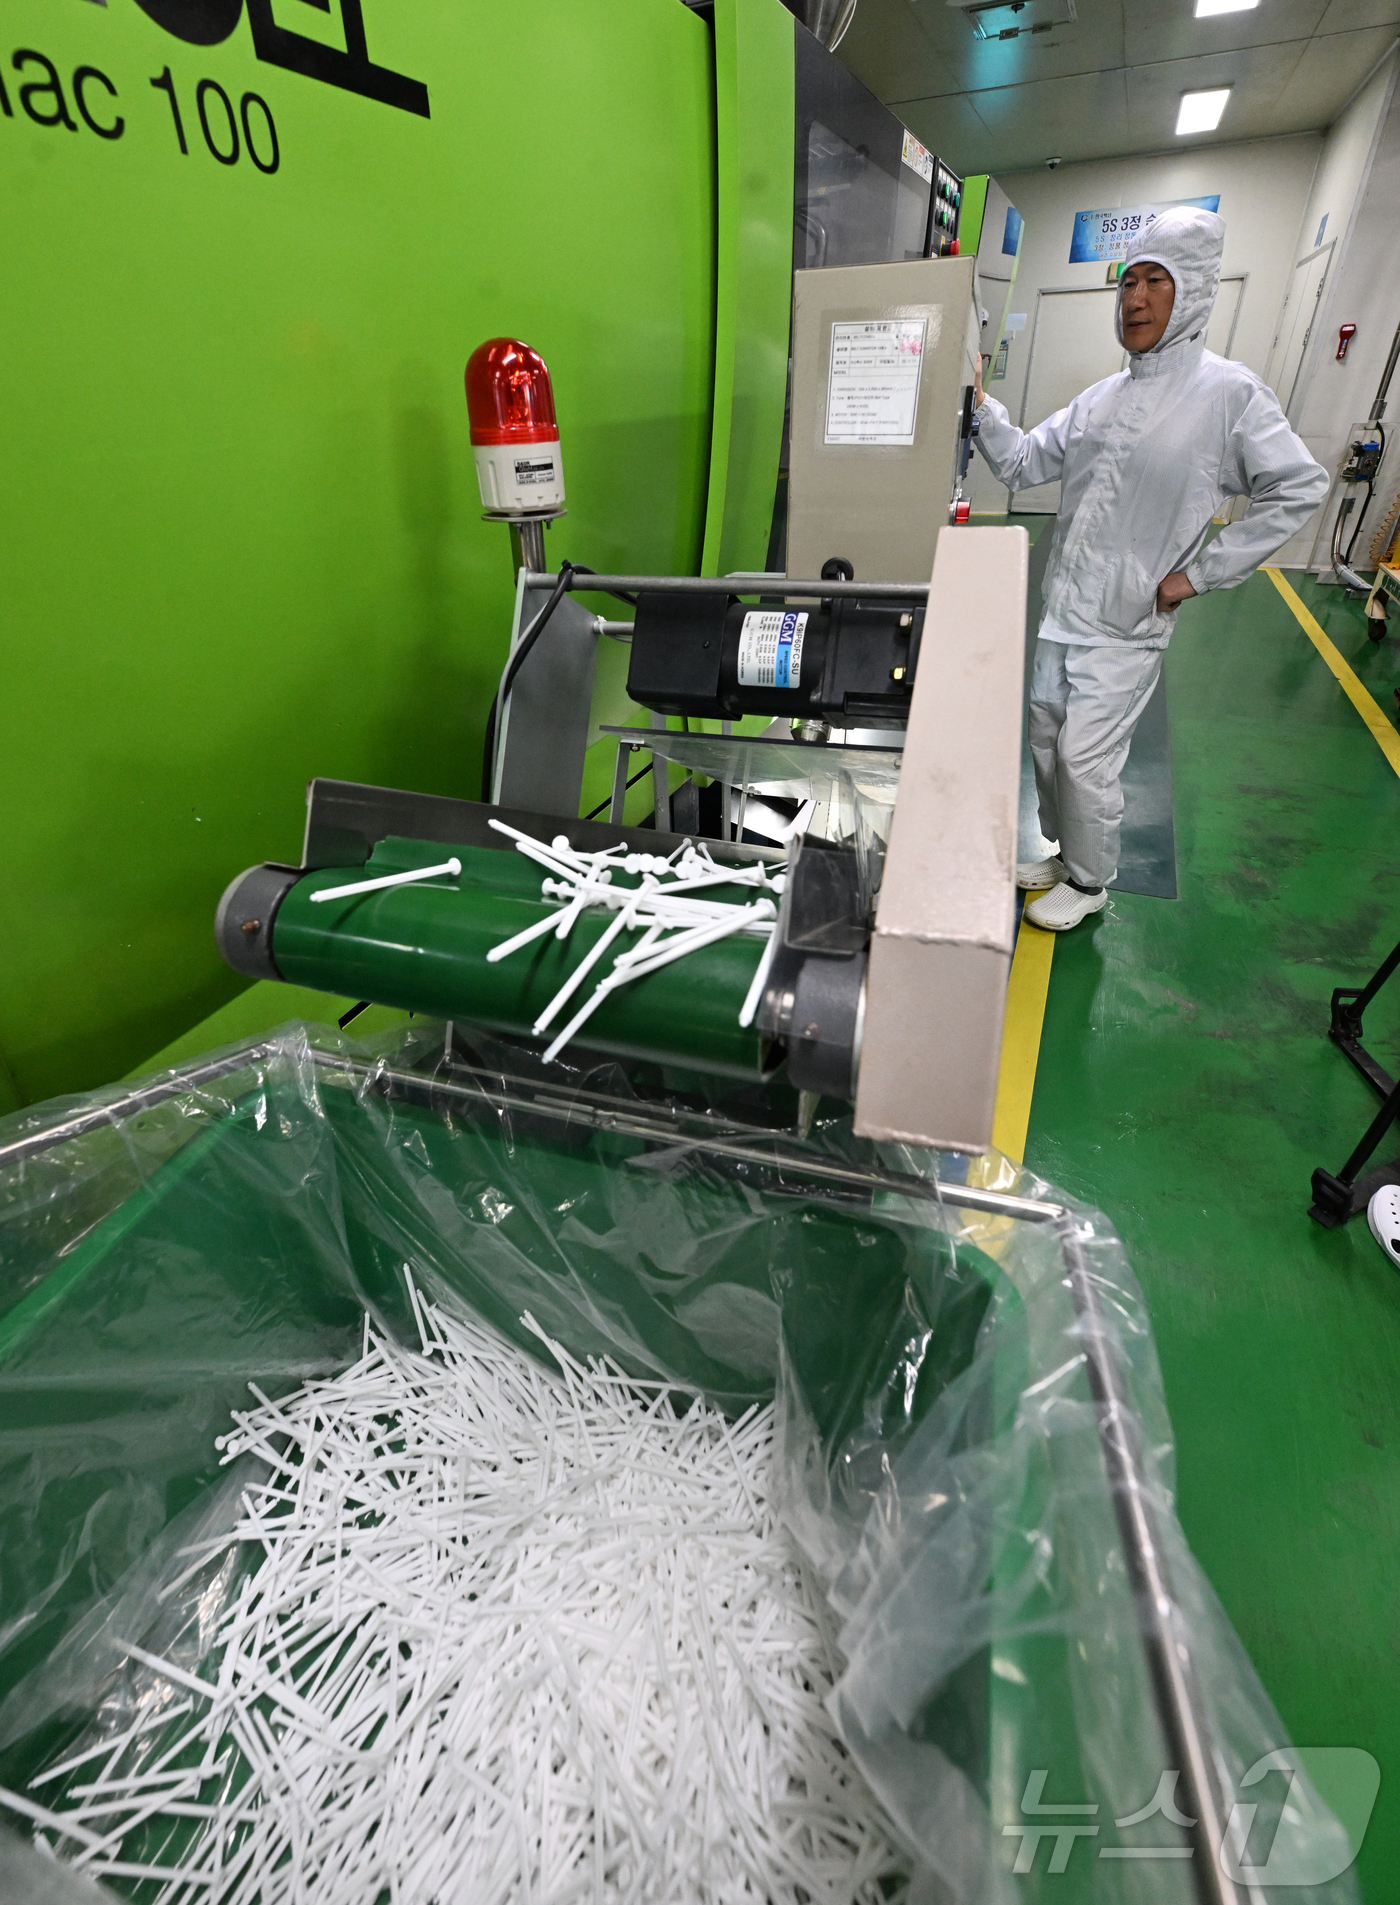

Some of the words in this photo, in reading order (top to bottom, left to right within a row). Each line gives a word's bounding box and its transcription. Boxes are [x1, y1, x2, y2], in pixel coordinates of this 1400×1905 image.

[0, 47, 125, 140] ac
[149, 64, 280, 174] 100
[1101, 218, 1118, 233] 5S
[1120, 214, 1142, 231] 3정
[780, 613, 797, 643] GGM
